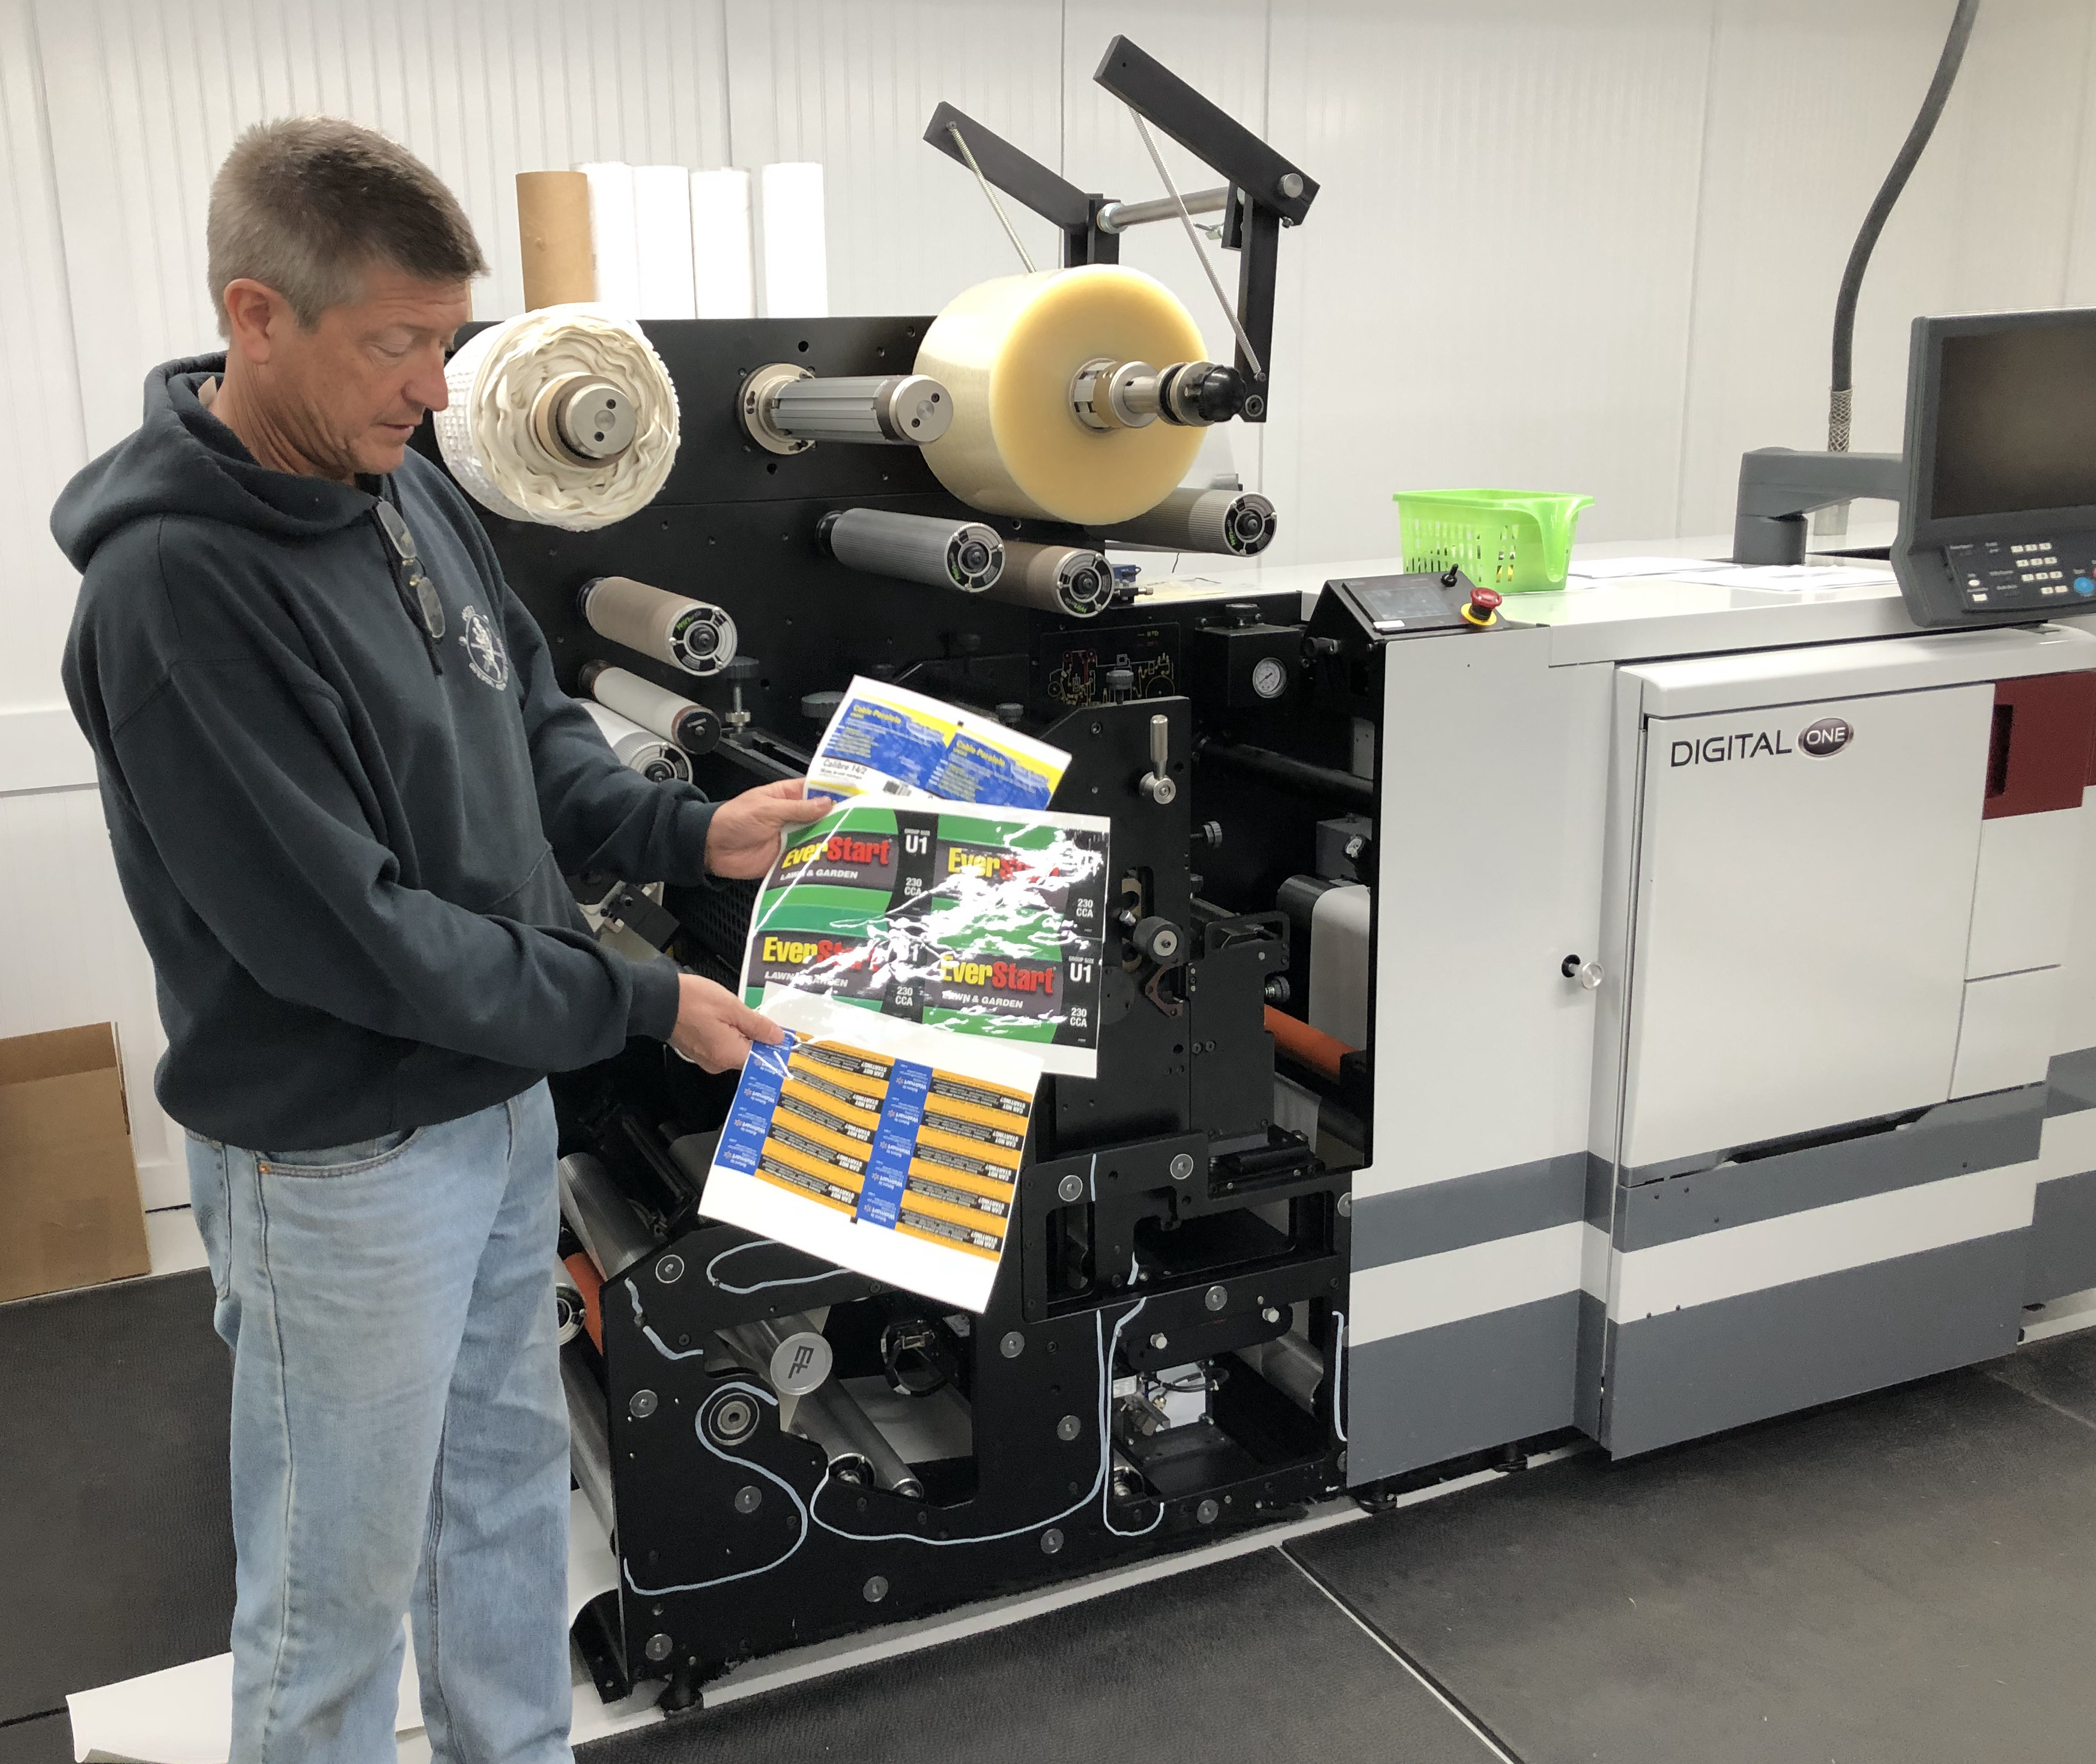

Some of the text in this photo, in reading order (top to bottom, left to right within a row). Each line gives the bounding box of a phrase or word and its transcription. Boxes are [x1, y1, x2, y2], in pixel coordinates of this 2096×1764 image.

[1671, 726, 1846, 767] DIGITAL ONE
[905, 834, 927, 854] U1
[781, 836, 890, 869] EverStart
[816, 869, 858, 879] GARDEN
[905, 877, 922, 887] 230
[904, 886, 921, 896] CCA
[1077, 898, 1093, 908] 230
[1076, 908, 1094, 918] CCA
[1070, 962, 1091, 983] U1
[897, 986, 913, 996] 230
[895, 995, 913, 1006] CCA
[981, 996, 1023, 1009] GARDEN
[1071, 1007, 1087, 1017] 230
[1070, 1016, 1087, 1027] CCA
